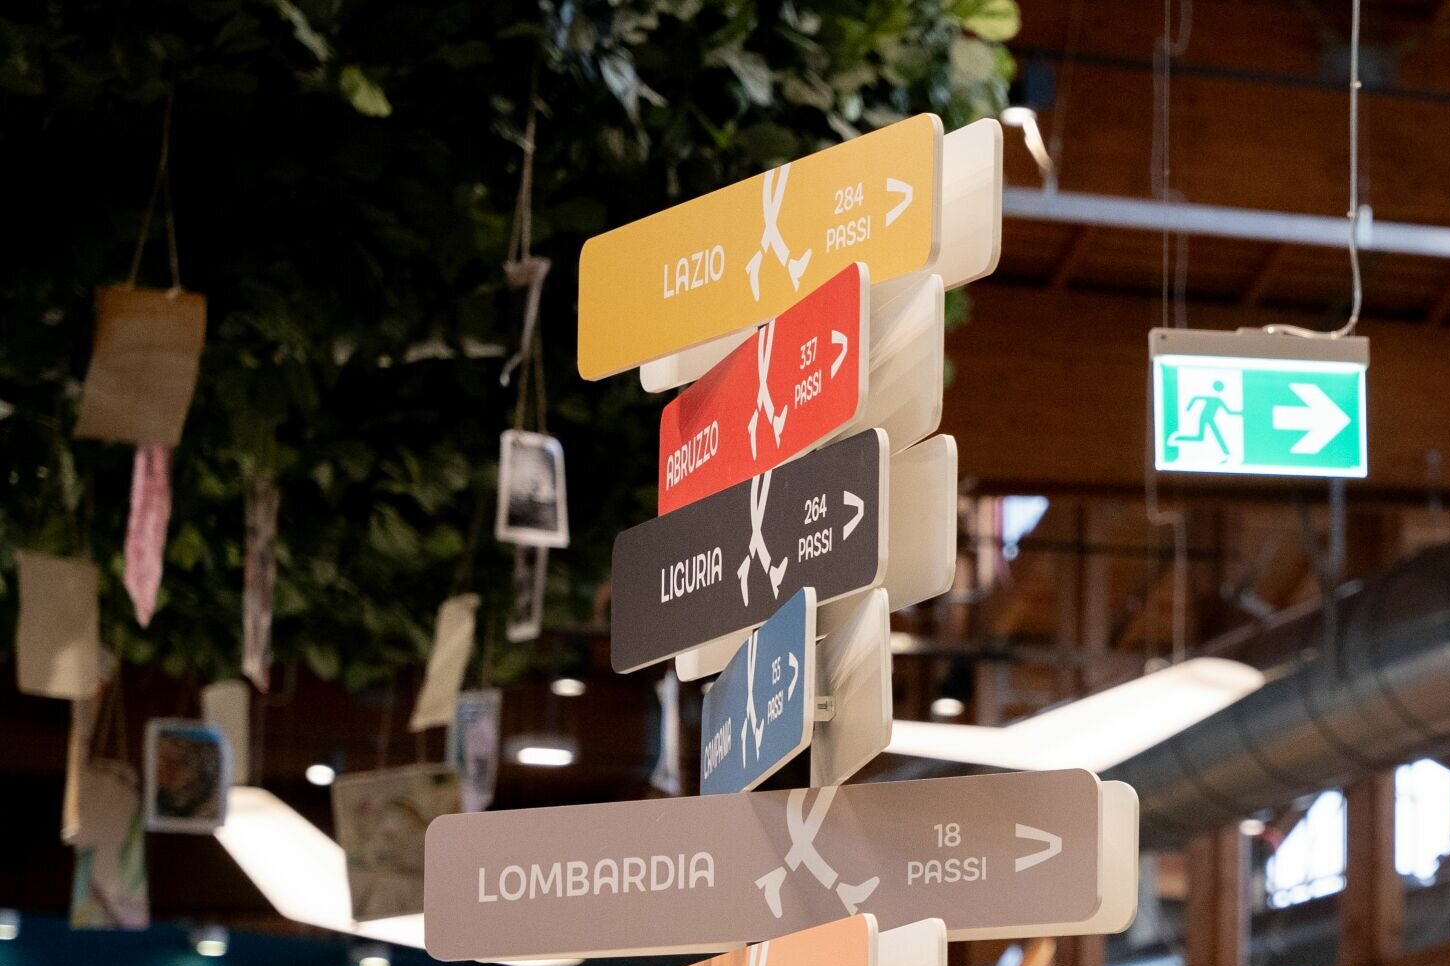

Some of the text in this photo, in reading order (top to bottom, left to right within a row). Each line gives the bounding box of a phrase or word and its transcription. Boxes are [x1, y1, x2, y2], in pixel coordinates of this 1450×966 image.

[834, 182, 864, 216] 284
[826, 216, 871, 254] PASSI
[662, 244, 726, 300] LAZIO
[799, 336, 818, 368] 337
[794, 369, 822, 409] PASSI
[666, 421, 719, 491] ABRUZZO
[804, 493, 827, 525] 264
[798, 527, 833, 563] PASSI
[660, 546, 722, 604] LIGURIA
[767, 689, 784, 725] PASSI
[703, 717, 732, 780] CAMPANIA
[933, 821, 961, 849] 18
[477, 851, 715, 903] LOMBARDIA
[907, 856, 988, 887] PASSI
